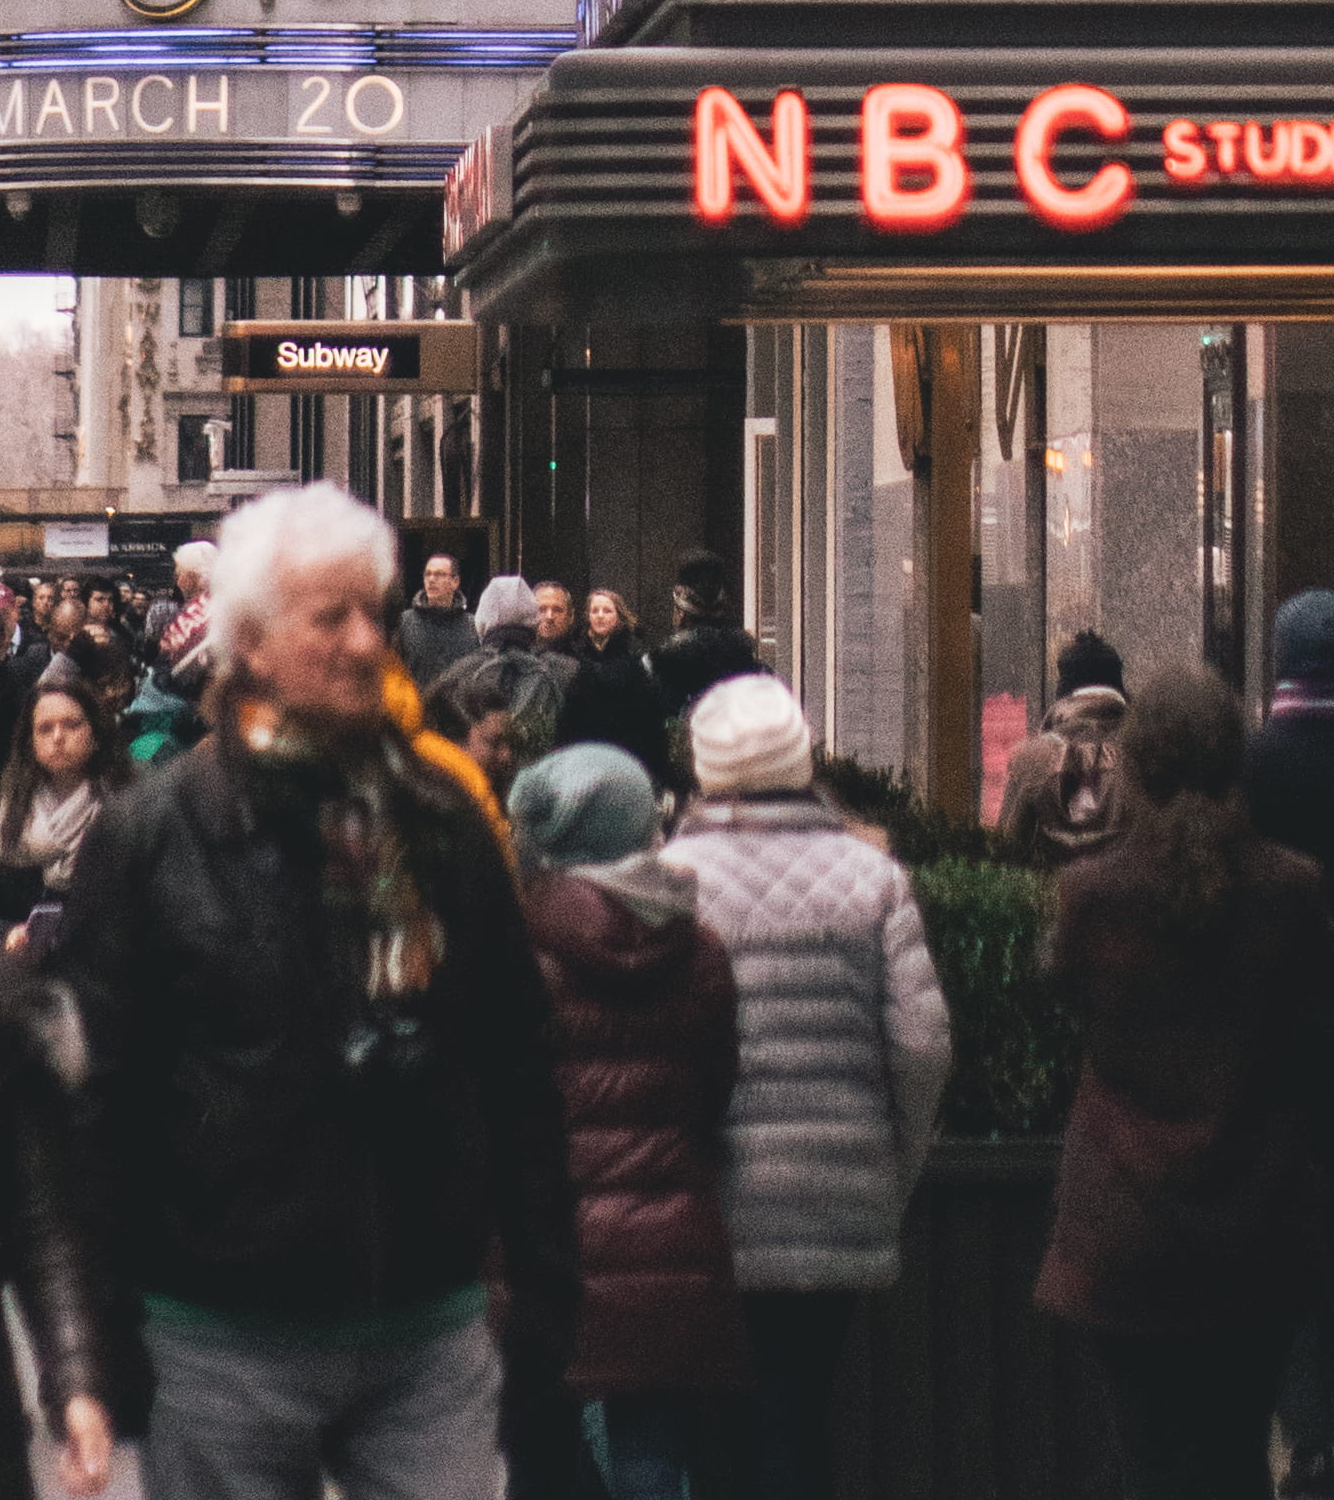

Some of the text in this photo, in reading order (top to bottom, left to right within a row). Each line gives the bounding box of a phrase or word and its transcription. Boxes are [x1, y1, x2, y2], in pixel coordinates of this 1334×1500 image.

[295, 74, 405, 136] 20
[691, 82, 1134, 228] NBC
[277, 341, 389, 374] Subway
